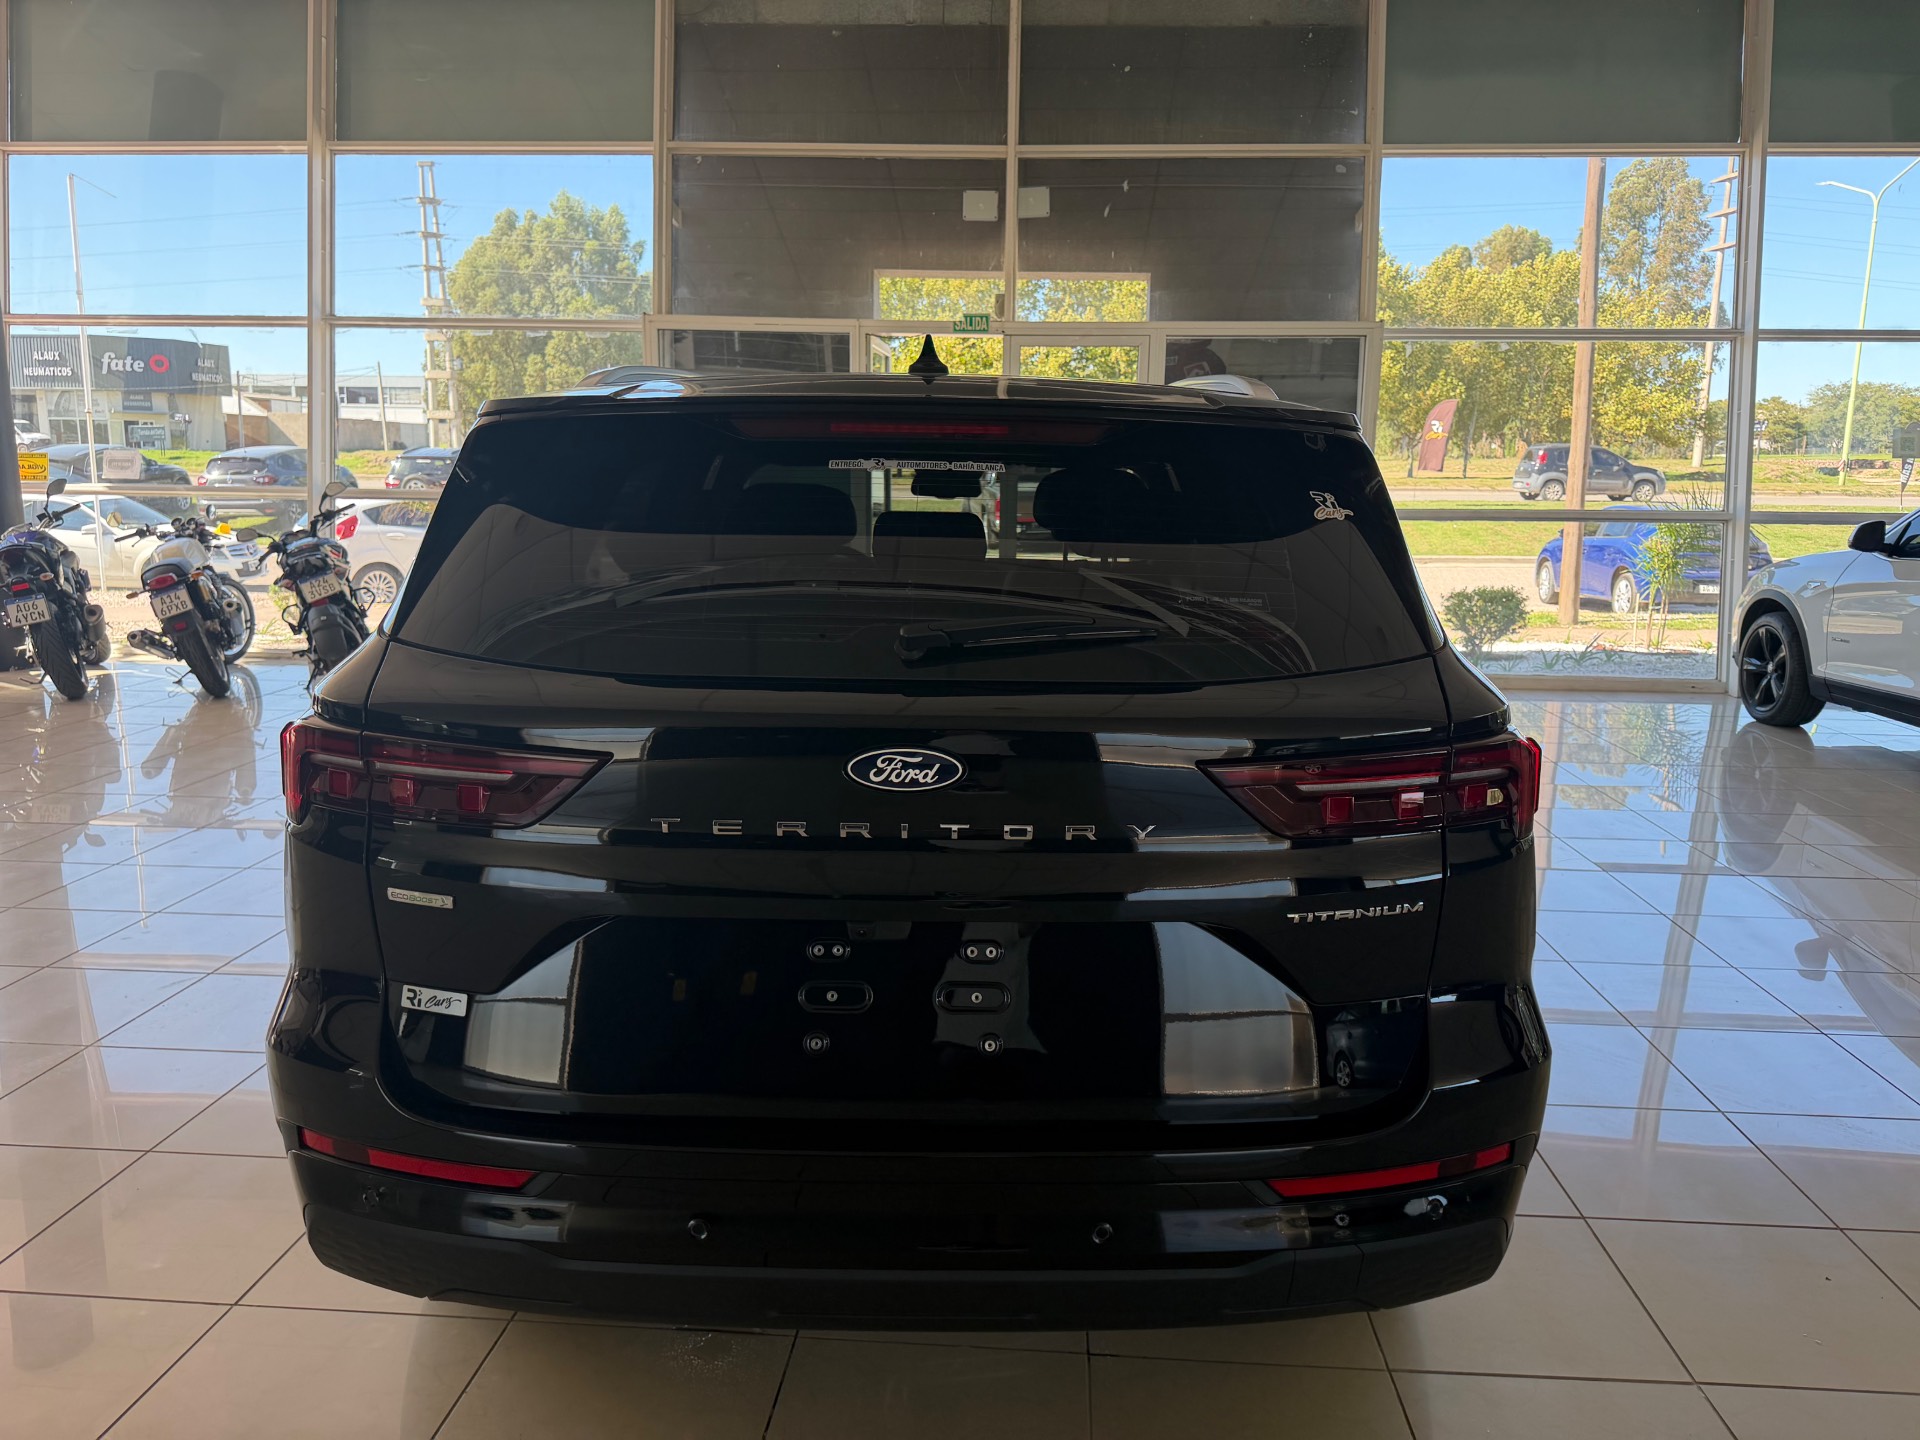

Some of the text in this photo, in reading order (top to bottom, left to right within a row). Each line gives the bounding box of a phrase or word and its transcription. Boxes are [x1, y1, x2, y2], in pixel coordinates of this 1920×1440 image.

[955, 316, 988, 331] SALIDA
[33, 350, 60, 361] ALAUX
[197, 357, 215, 368] ALAUX
[101, 351, 145, 375] fate
[23, 366, 73, 377] NEUMATICOS
[830, 459, 864, 469] ENTREGÓ:
[896, 461, 948, 470] AUTOMOTORES
[953, 461, 975, 470] BAHÍA
[976, 463, 1004, 472] BLANCA
[160, 592, 181, 606] A14
[160, 600, 188, 617] 6PXB
[15, 610, 46, 624] 4YCN
[869, 754, 941, 783] Ford
[650, 817, 1157, 842] TERRITORY
[390, 891, 440, 905] ECOBOOST
[1286, 901, 1424, 924] TITANIUM
[424, 995, 462, 1010] Cars
